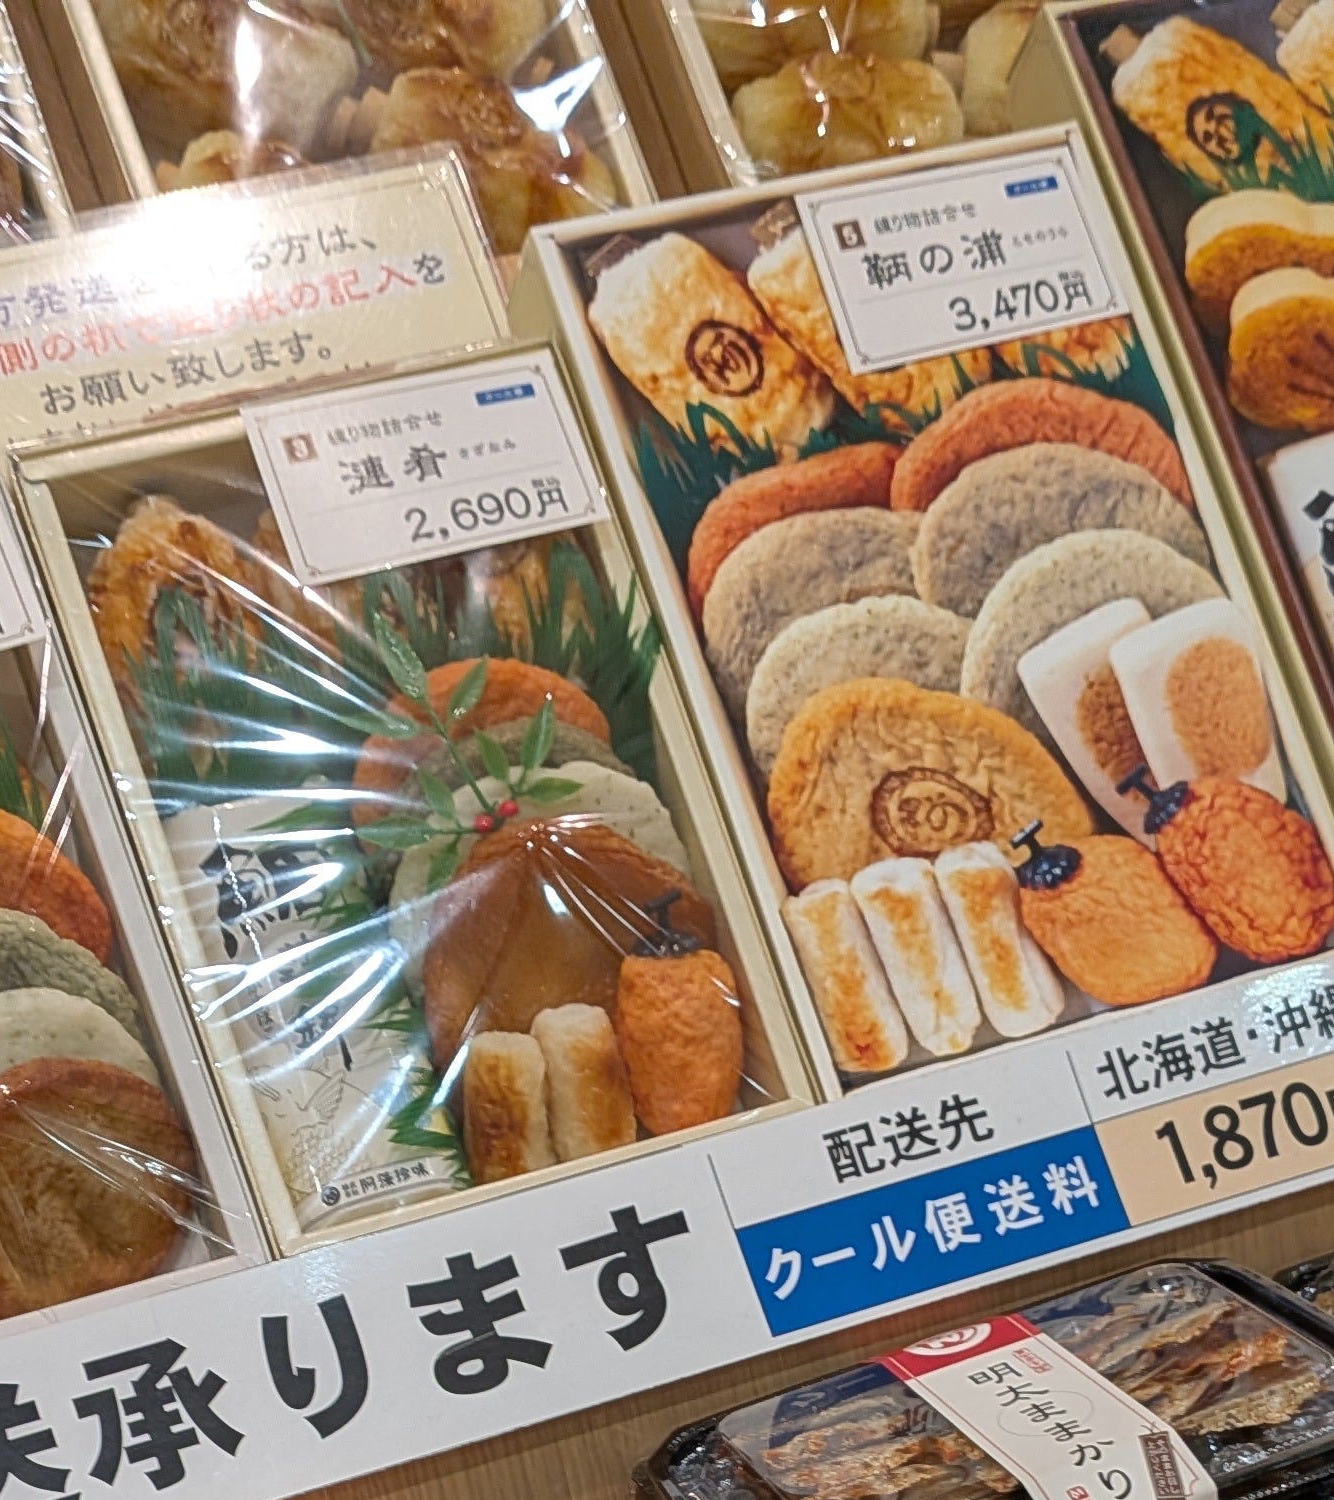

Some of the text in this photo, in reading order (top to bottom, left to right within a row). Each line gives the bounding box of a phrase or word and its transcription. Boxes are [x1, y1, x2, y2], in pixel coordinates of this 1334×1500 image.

[949, 278, 1093, 331] 3,470円
[40, 329, 334, 415] お願い致します。
[404, 485, 570, 544] 2,690円
[822, 1095, 994, 1185] 配送先
[763, 1156, 1100, 1305] クール便送料
[967, 1361, 1133, 1500] 明太ままかり
